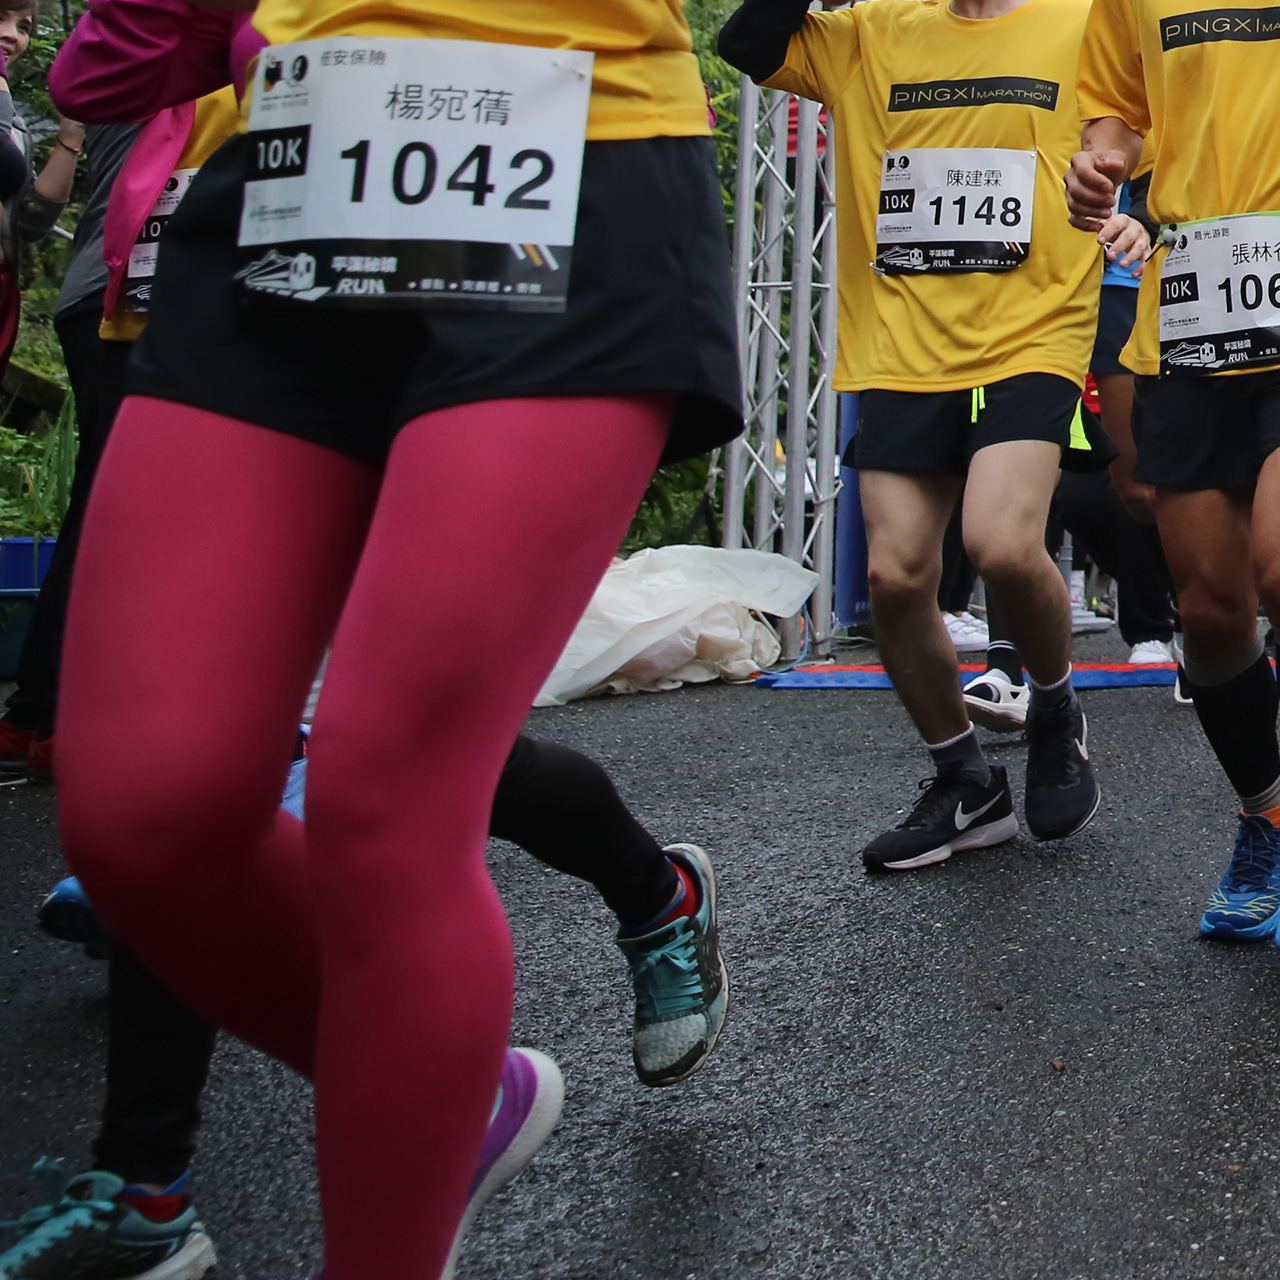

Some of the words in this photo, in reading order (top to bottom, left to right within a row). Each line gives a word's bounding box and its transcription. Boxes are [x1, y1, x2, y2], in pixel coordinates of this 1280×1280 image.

[1166, 17, 1260, 41] PINGXI
[895, 86, 975, 105] PINGXI
[976, 89, 1052, 102] MARATHON
[1035, 83, 1053, 91] 2018
[385, 83, 514, 126] 楊宛蒨
[257, 138, 303, 170] 10K
[340, 139, 555, 211] 1042
[946, 169, 1002, 187] 陳建霖
[885, 194, 909, 210] 10K
[929, 195, 1022, 227] 1148
[142, 220, 168, 238] 10
[932, 259, 951, 268] RUN
[335, 278, 386, 294] RUN
[1165, 280, 1191, 300] 10K
[1228, 352, 1249, 363] RUN
